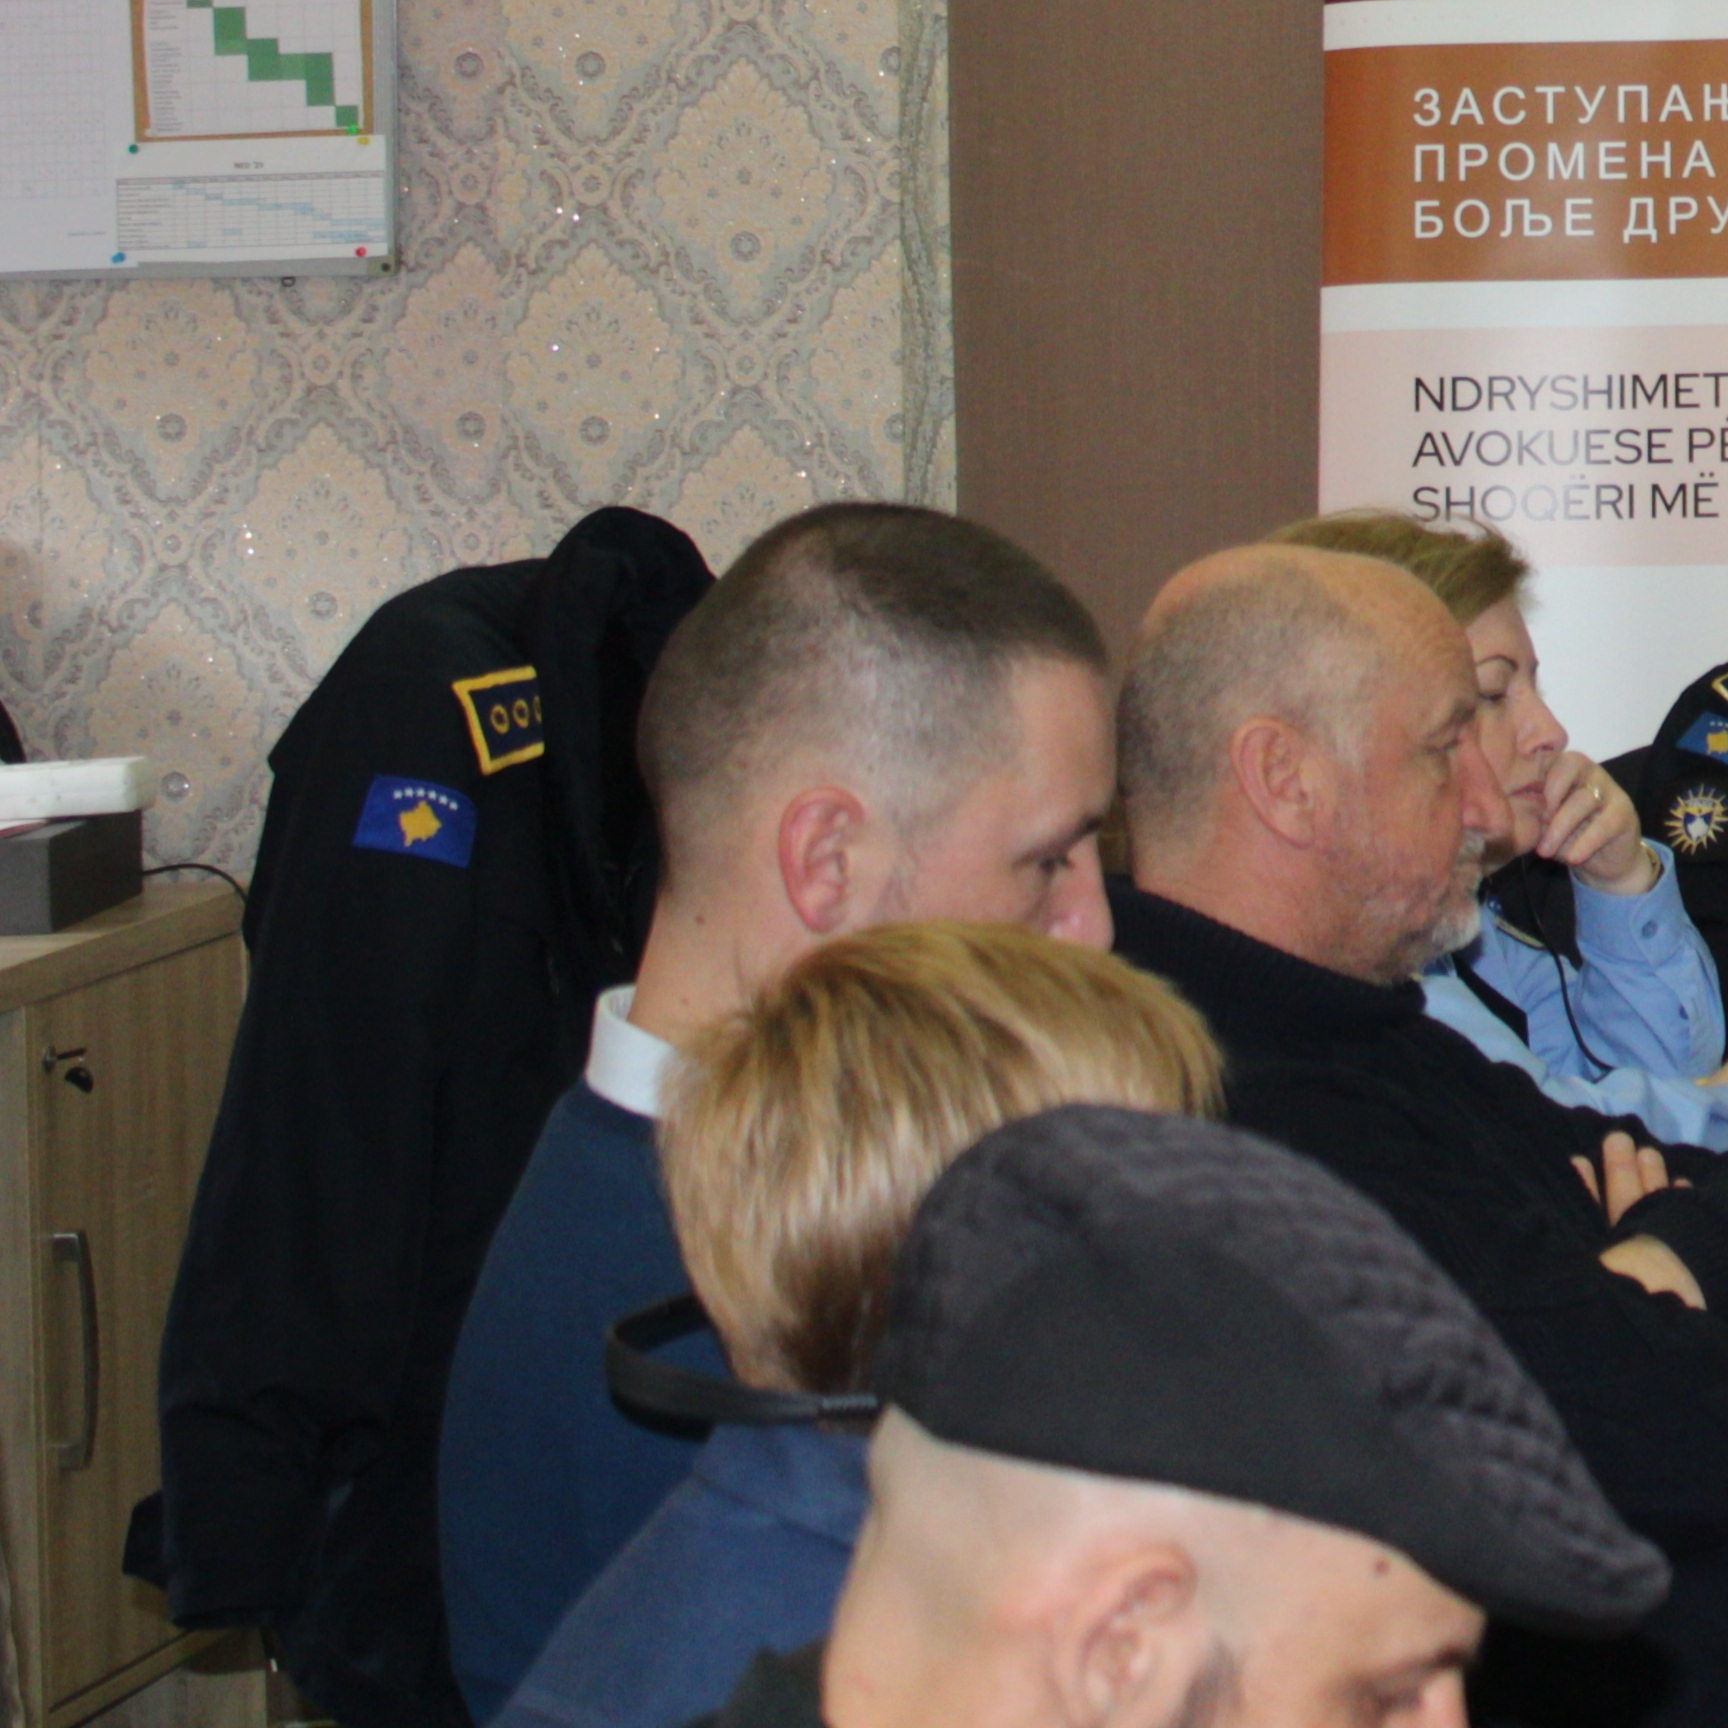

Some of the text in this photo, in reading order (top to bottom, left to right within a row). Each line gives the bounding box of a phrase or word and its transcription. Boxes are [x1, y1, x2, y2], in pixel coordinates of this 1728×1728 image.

[1413, 139, 1716, 182] ПРОМЕНА
[1413, 198, 1595, 240] БОЉЕ
[1412, 427, 1672, 468] AVOKUESE
[1412, 474, 1634, 521] SHOQËRI
[1651, 472, 1720, 518] MË
